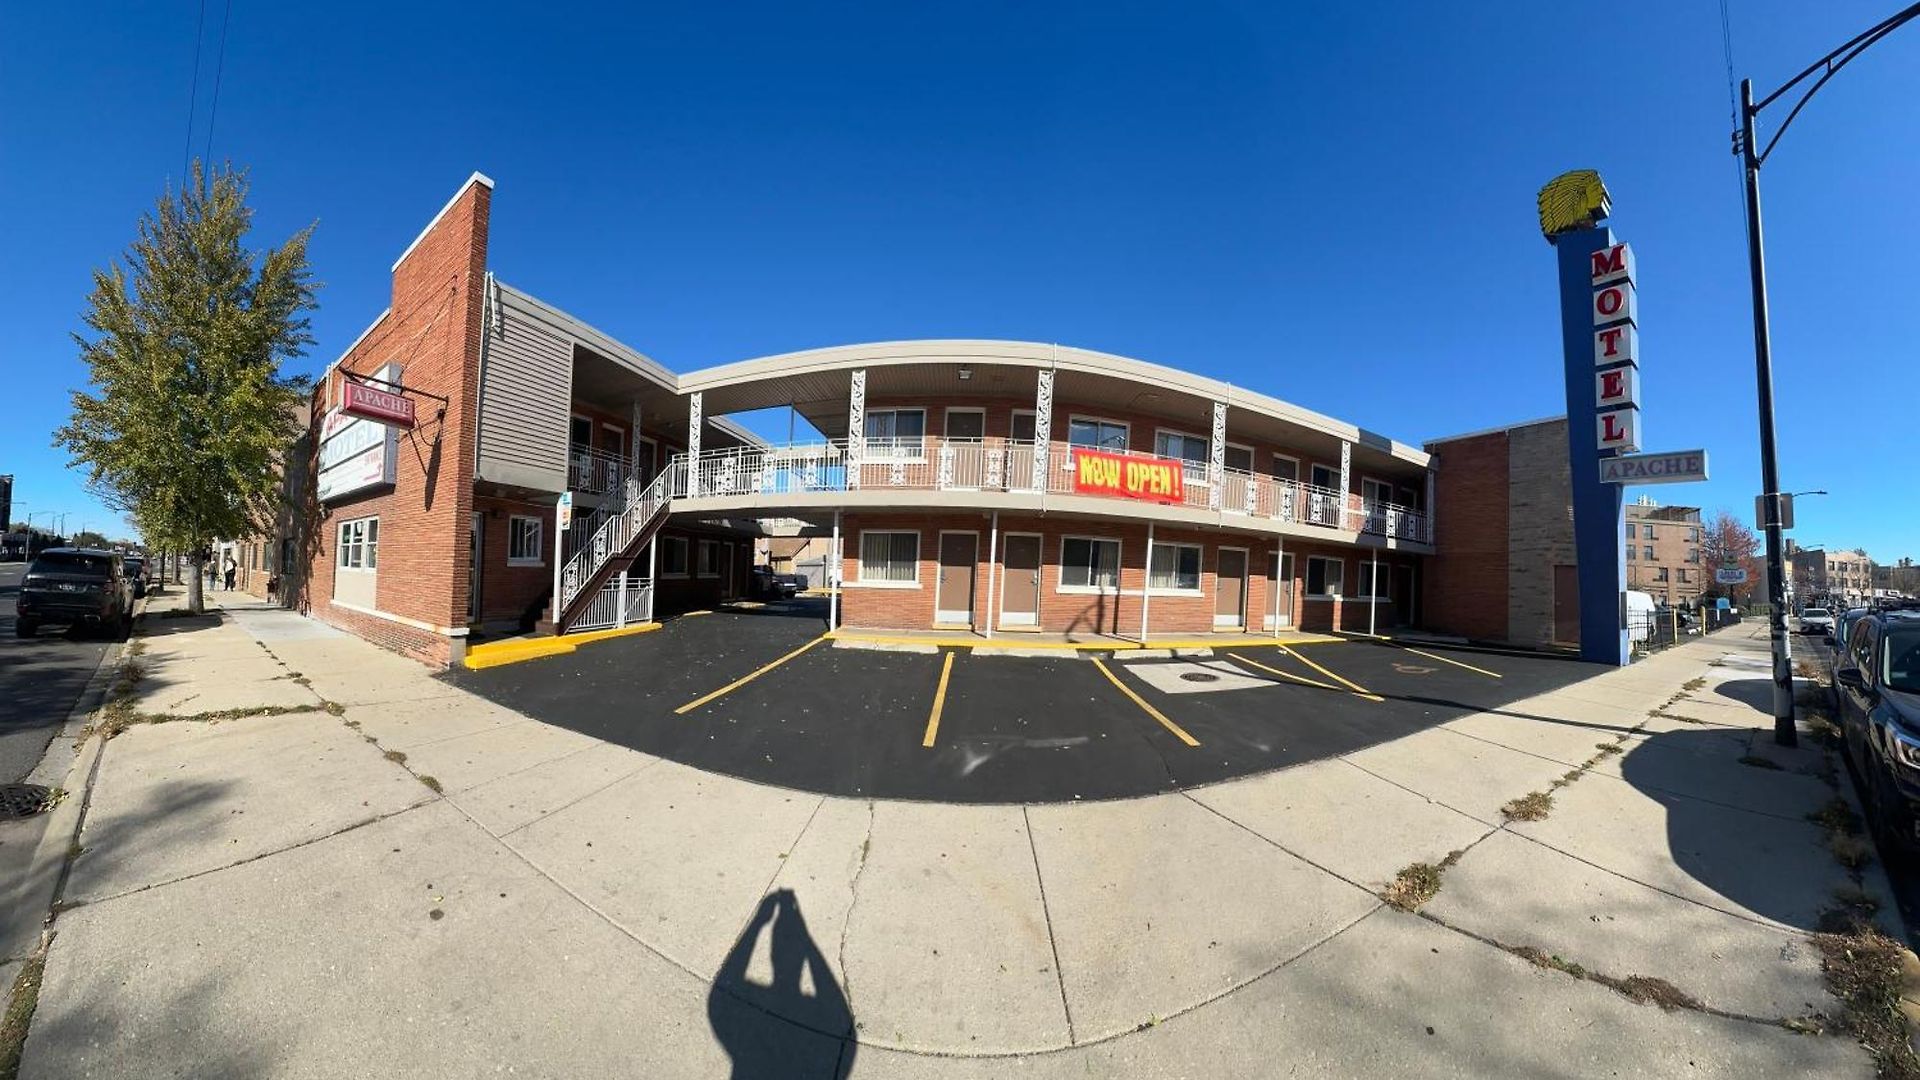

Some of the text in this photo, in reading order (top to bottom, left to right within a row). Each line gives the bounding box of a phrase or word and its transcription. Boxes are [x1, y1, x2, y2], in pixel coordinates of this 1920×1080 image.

[1592, 245, 1626, 441] MOTEL
[354, 389, 410, 413] APACHE
[1079, 455, 1179, 496] NOW OPEN!
[1606, 456, 1700, 479] APACHE
